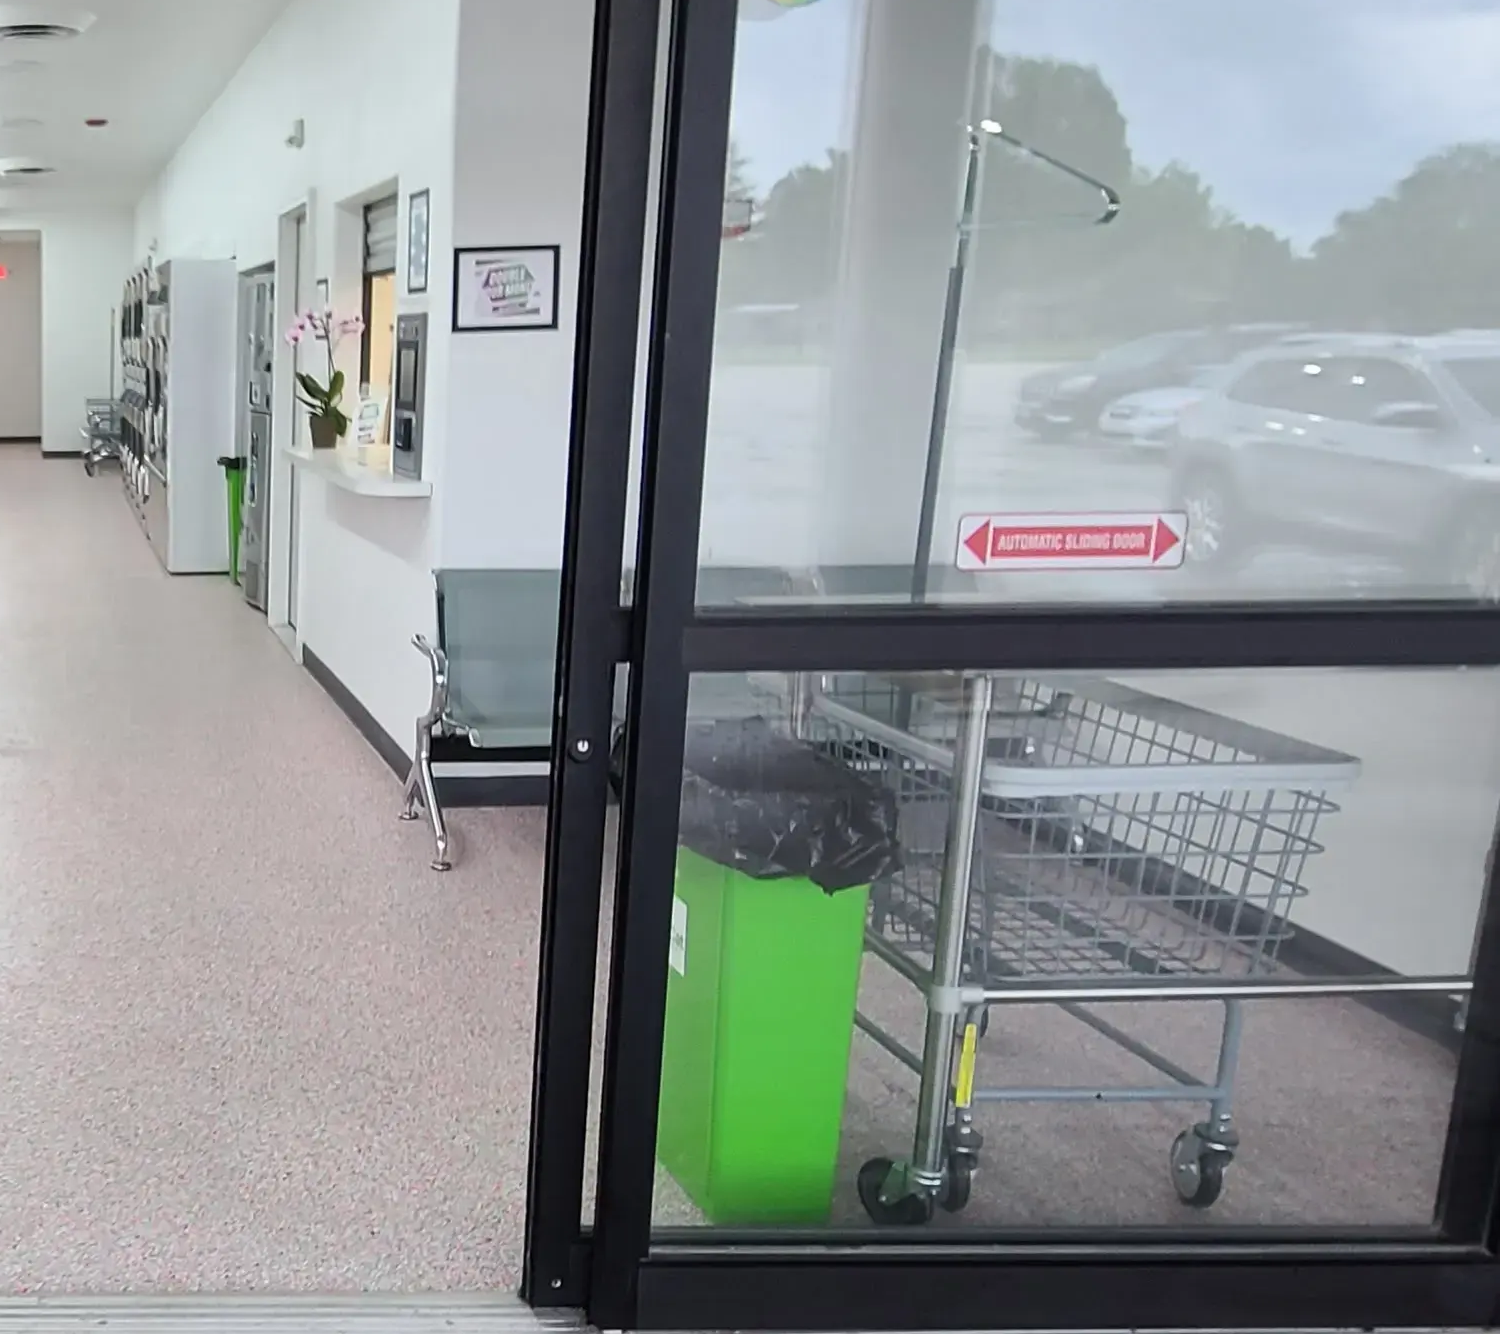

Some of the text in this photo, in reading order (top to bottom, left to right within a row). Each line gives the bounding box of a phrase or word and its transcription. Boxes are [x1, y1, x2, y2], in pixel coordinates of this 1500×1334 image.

[997, 531, 1145, 552] AUTOMATIC SLIDING DOOR
